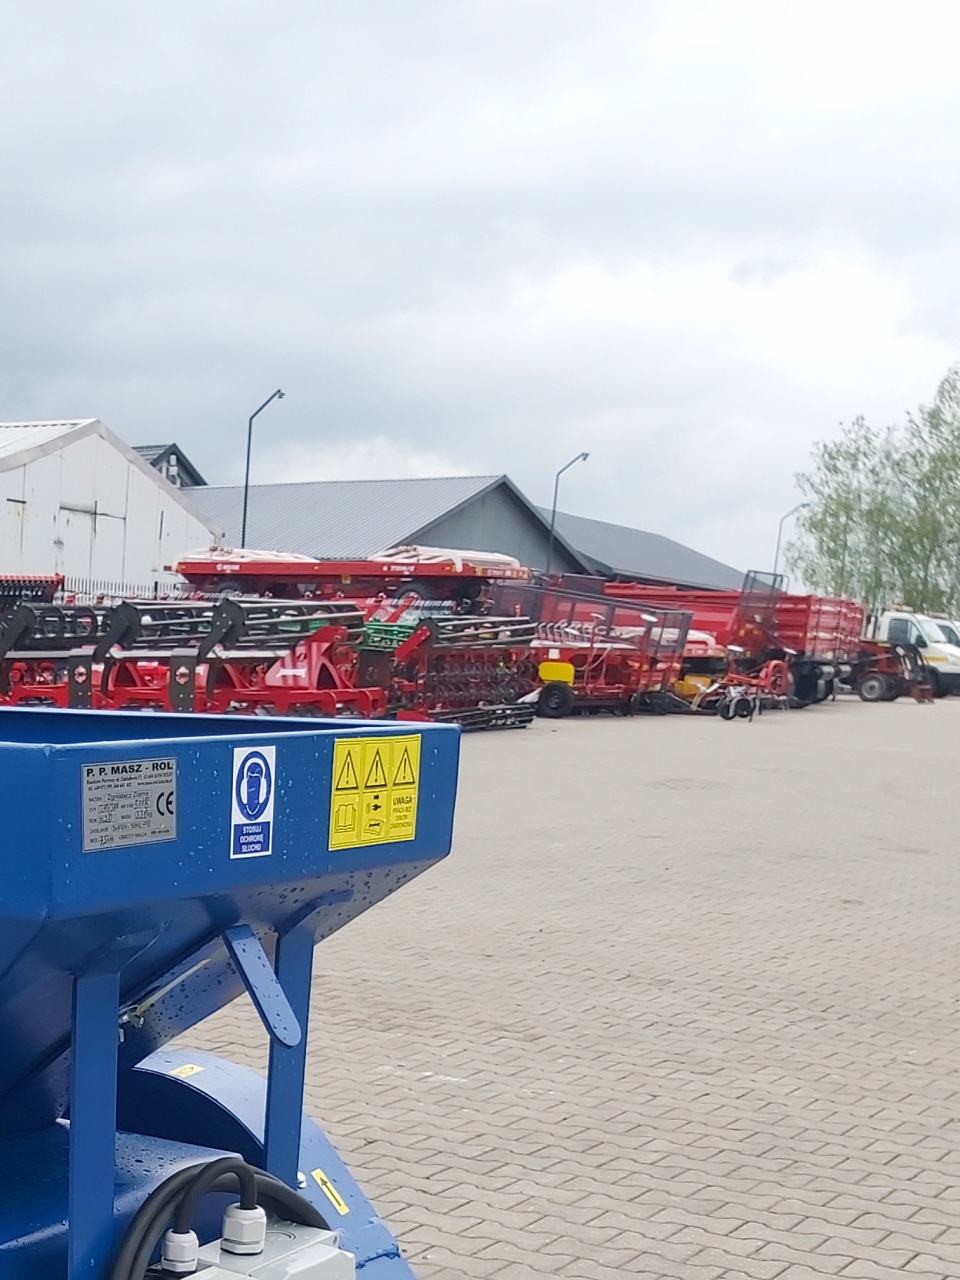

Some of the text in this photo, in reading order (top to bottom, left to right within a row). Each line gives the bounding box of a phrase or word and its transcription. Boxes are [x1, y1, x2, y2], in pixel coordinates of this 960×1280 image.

[87, 768, 95, 777] P.
[99, 767, 107, 776] P.
[111, 764, 142, 775] MASZ
[152, 761, 173, 771] ROL
[393, 796, 412, 806] UWAGA
[243, 825, 262, 834] STOSUJ
[240, 834, 264, 844] OCHRONĘ
